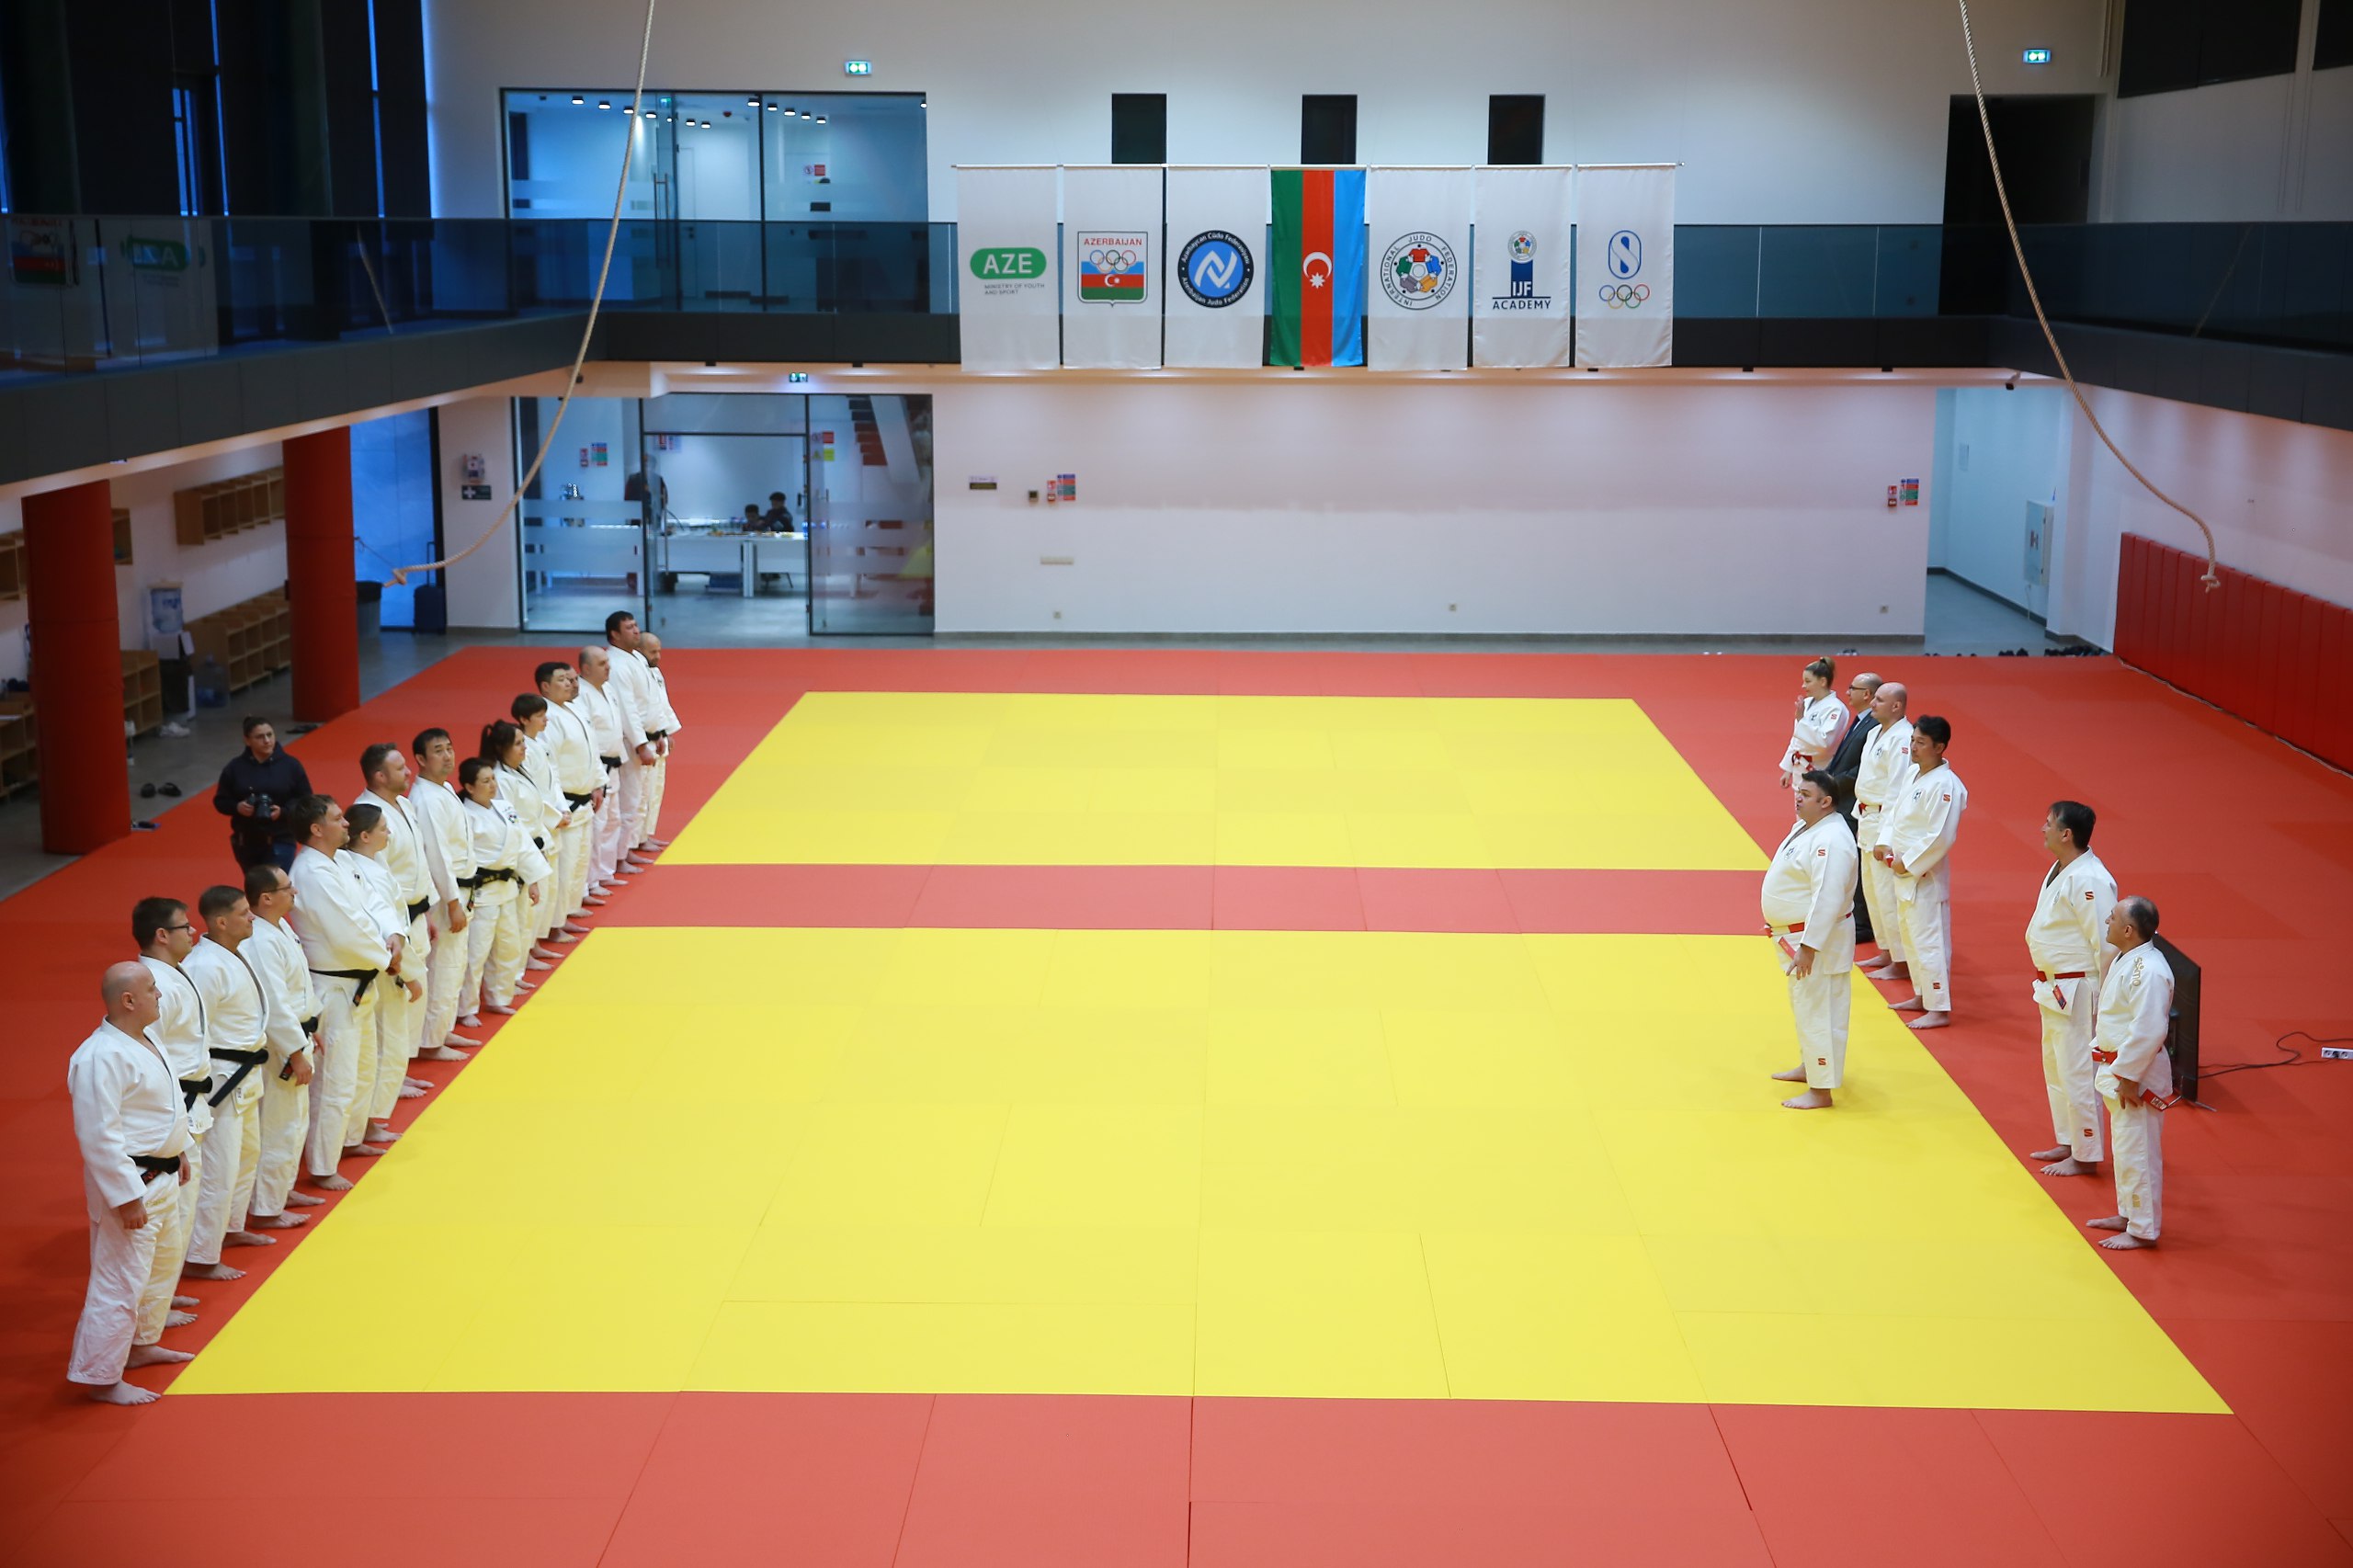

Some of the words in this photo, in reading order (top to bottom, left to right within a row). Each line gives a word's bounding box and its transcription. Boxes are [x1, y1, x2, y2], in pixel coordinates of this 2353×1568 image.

[983, 254, 1033, 275] AZE
[1383, 245, 1413, 306] INTERNATIONAL
[1408, 234, 1432, 243] JUDO
[1435, 245, 1455, 301] FEDERATION
[1512, 281, 1532, 297] IJF
[1492, 300, 1552, 311] ACADEMY
